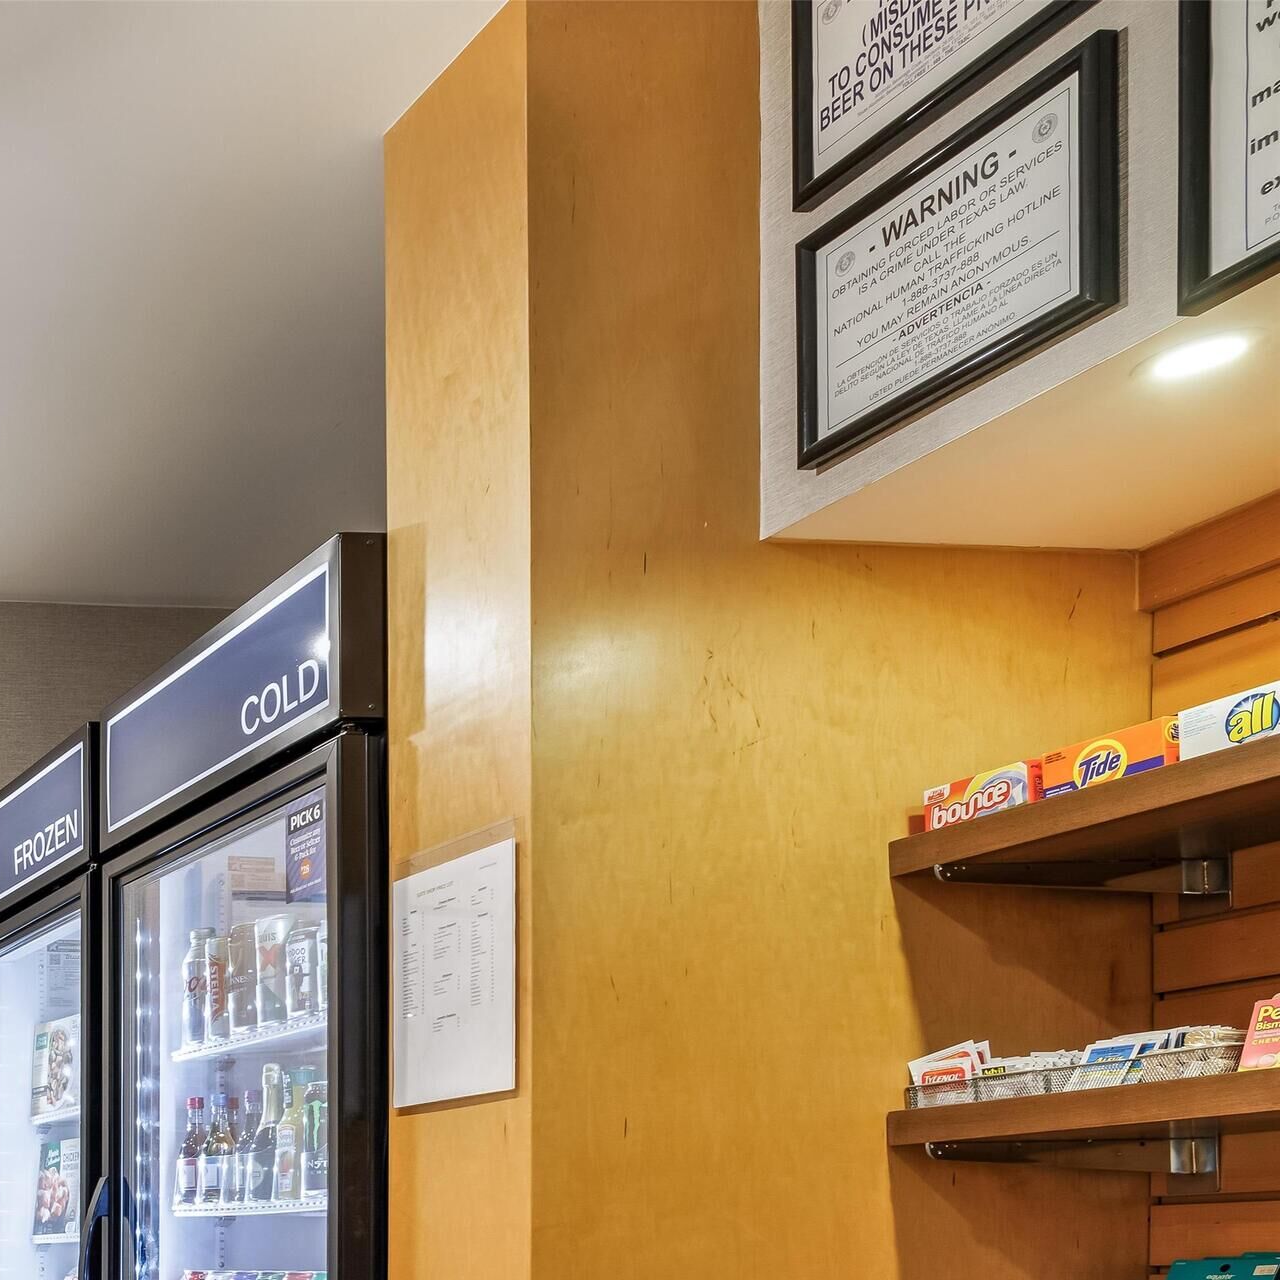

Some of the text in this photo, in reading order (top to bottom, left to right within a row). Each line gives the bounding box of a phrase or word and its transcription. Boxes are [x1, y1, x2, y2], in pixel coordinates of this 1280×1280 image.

[820, 80, 864, 132] BEER
[870, 56, 894, 92] ON
[899, 5, 958, 69] THESE
[828, 66, 850, 98] TO
[832, 141, 1062, 299] OBTAINING FORCED LABOR OR SERVICES
[882, 152, 999, 247] WARNING
[834, 185, 1061, 337] NATIONAL HUMAN TRAFFICKING HOTLINE
[859, 178, 1028, 295] IS A CRIME UNDER TEXAS LAW.
[914, 232, 966, 272] CALL THE
[857, 236, 1031, 347] YOU MAY REMAIN ANONYMOUS.
[902, 251, 979, 306] 1-888-3737-888
[834, 258, 1062, 398] DELITO LEY LLAME DIRECTA
[837, 251, 1058, 388] LA DE SERVICIOS TRABAJO FORZADO ES UN
[876, 304, 997, 380] NACIONAL HUMANO
[898, 283, 983, 340] ADVERTENCIA
[868, 335, 975, 401] USTED PUEDE PERMANECER
[241, 659, 320, 736] COLD
[1228, 691, 1276, 743] all
[1078, 752, 1122, 788] Tide
[290, 804, 321, 831] PICK 6
[932, 783, 1009, 829] bounce
[13, 809, 79, 875] FROZEN
[210, 965, 220, 1012] STELLA
[924, 1073, 960, 1084] TYLENOL
[983, 1067, 1004, 1076] Advil
[1206, 1273, 1233, 1280] equate
